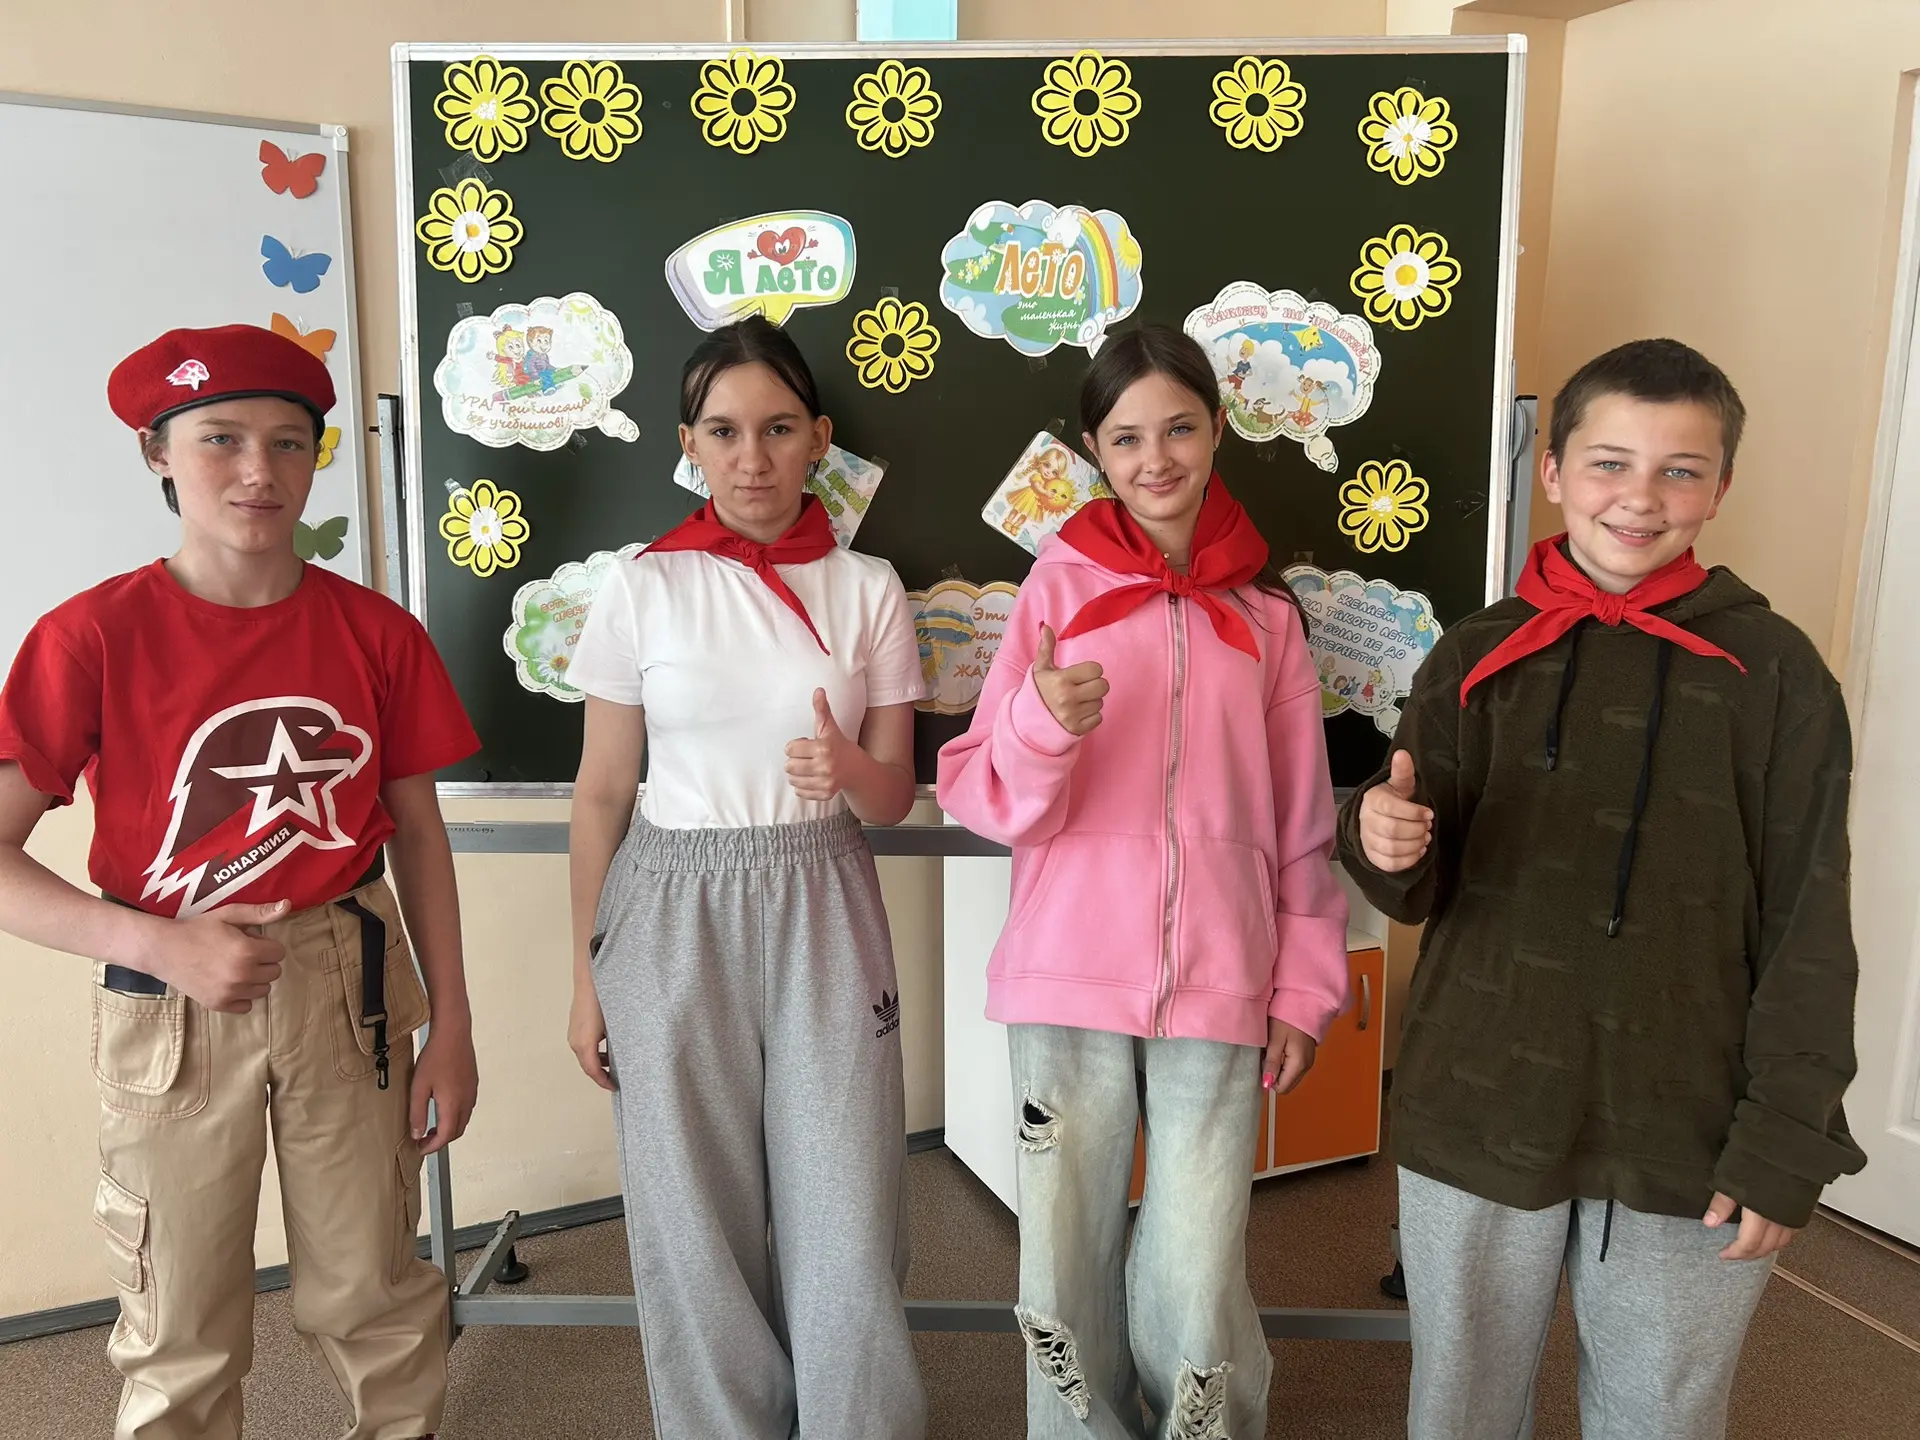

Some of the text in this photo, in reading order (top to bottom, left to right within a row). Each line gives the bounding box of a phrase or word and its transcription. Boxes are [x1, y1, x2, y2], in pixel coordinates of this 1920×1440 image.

[703, 249, 745, 295] Я
[1020, 309, 1077, 321] маленькая
[1326, 605, 1378, 632] ТАКОГО
[1337, 594, 1397, 623] ЖЕЛАЕМ
[1308, 632, 1383, 668] НТЕРНЕТА!
[1364, 636, 1383, 651] НЕ
[1384, 645, 1406, 660] ДО
[212, 826, 291, 884] ЮНАРМИЯ
[875, 1017, 900, 1038] adida
